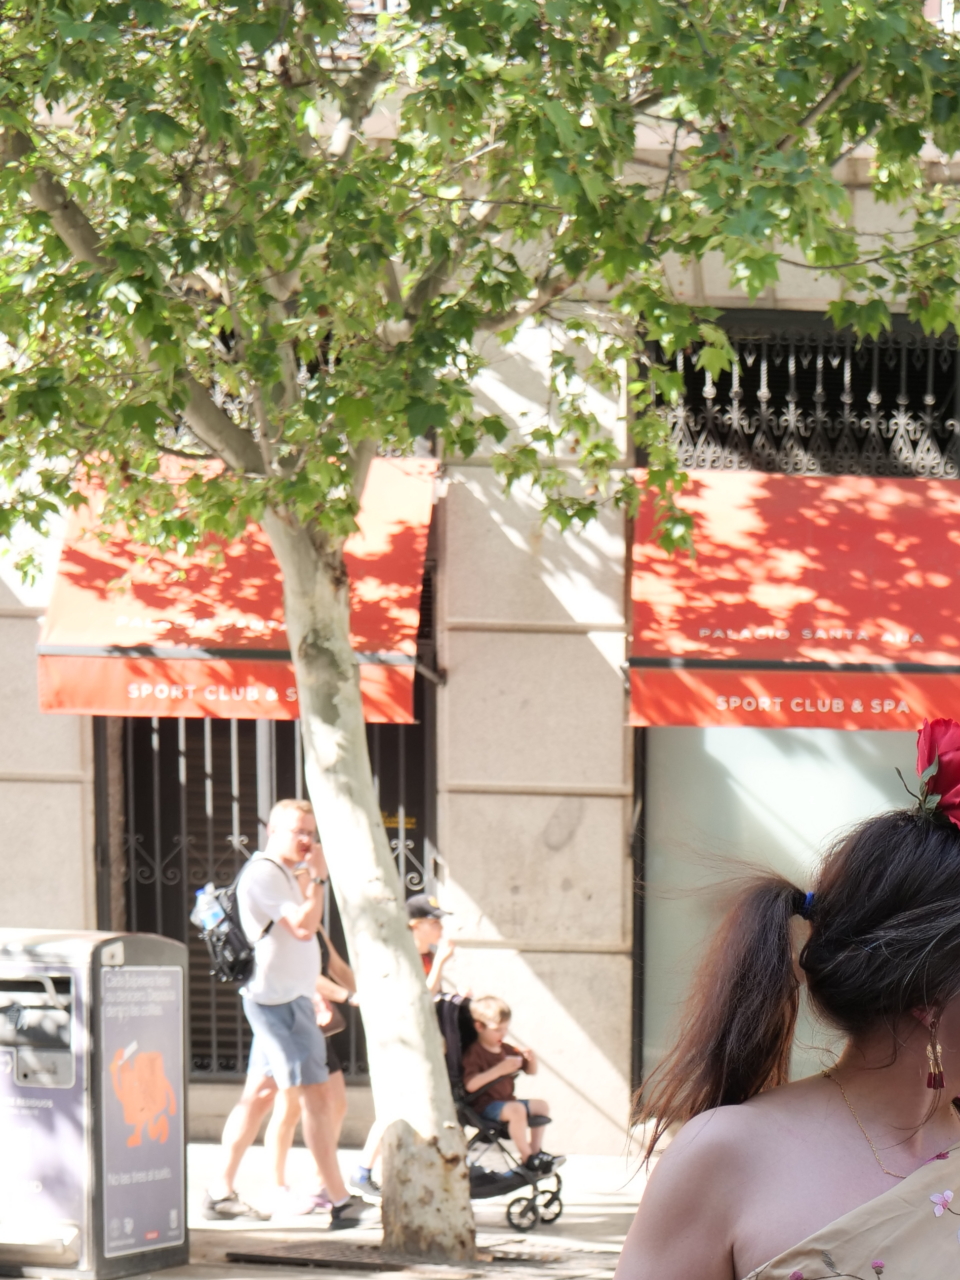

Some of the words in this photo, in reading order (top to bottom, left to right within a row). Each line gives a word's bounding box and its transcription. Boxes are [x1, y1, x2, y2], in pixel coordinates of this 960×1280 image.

[698, 627, 791, 641] PALACIO
[801, 628, 870, 642] SANTA
[880, 630, 924, 644] ANA
[127, 682, 197, 700] SPORT
[203, 684, 260, 702] CLUB
[264, 686, 279, 702] &
[715, 694, 784, 712] SPORT
[789, 696, 845, 714] CLUB
[850, 698, 864, 714] &
[870, 697, 911, 715] SPA
